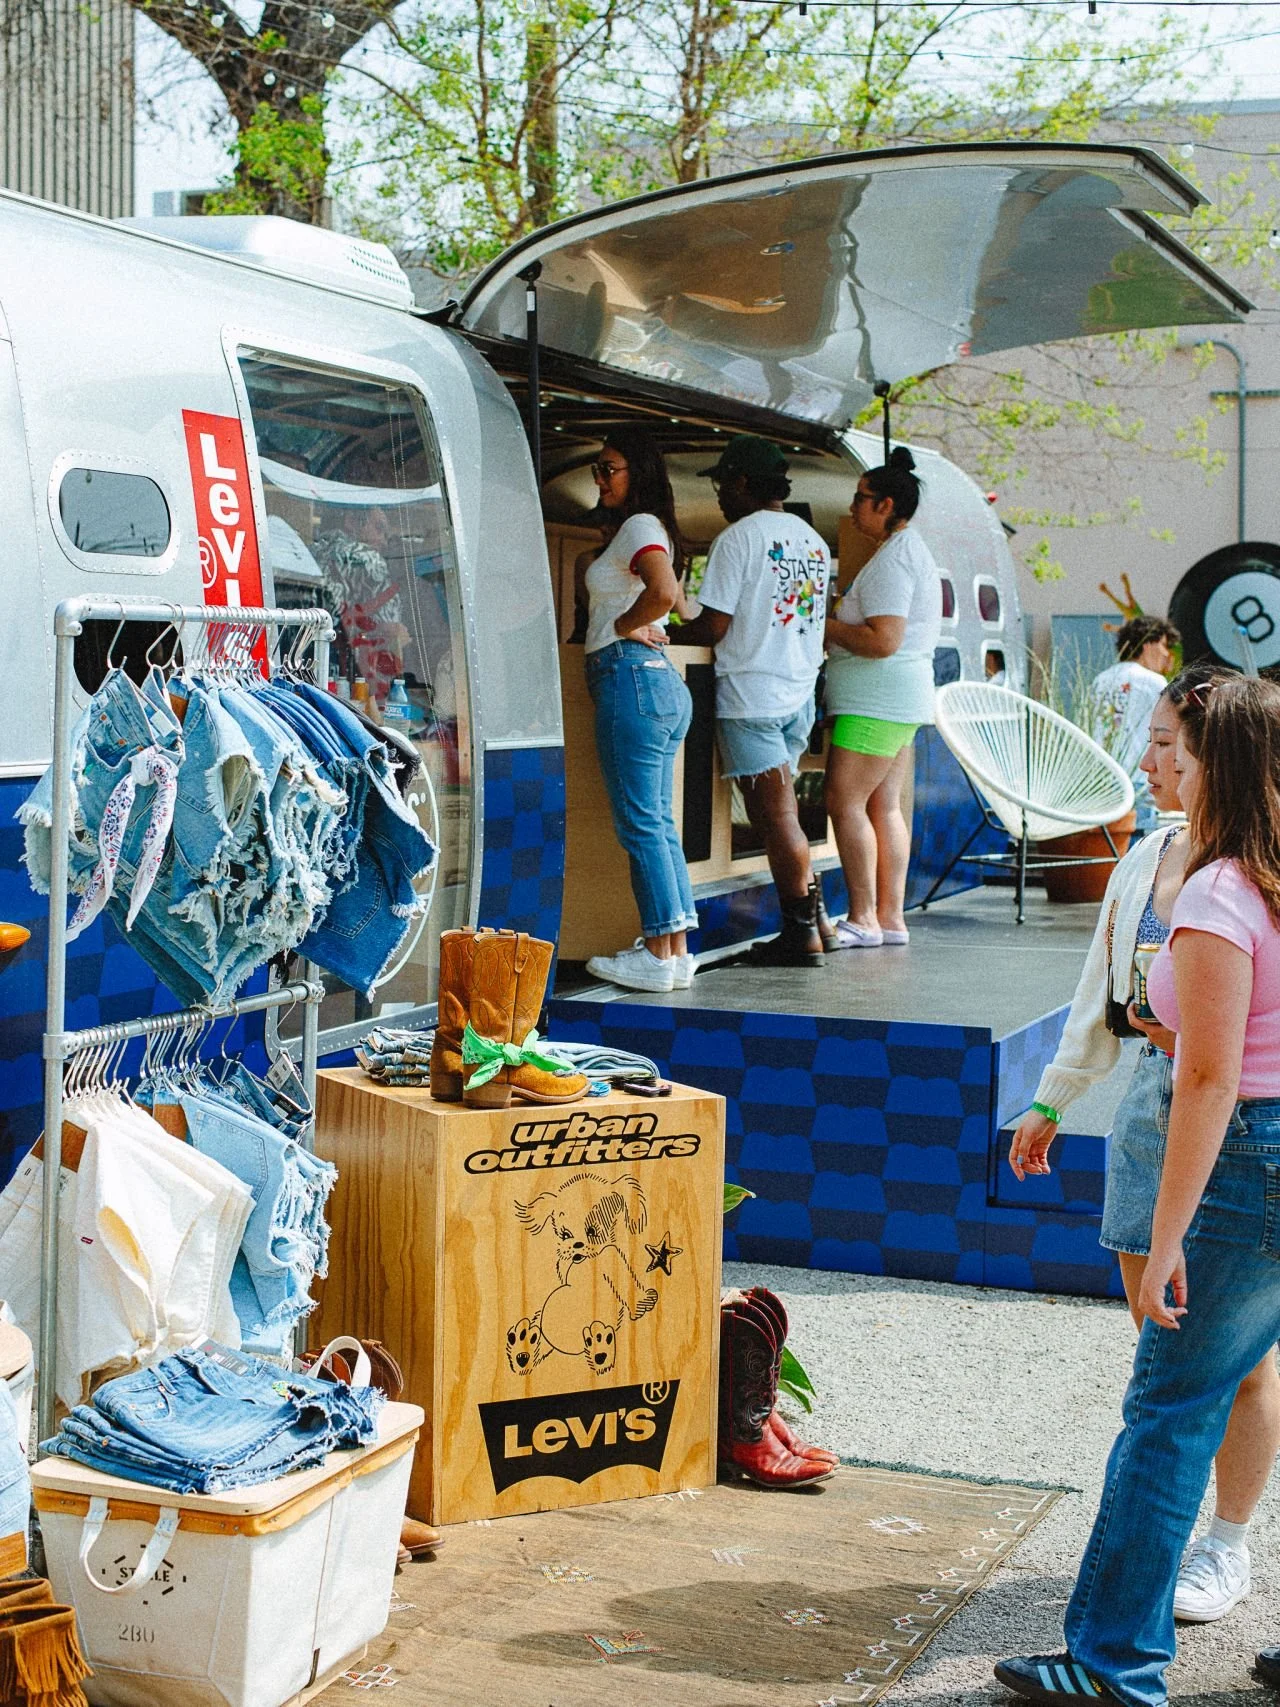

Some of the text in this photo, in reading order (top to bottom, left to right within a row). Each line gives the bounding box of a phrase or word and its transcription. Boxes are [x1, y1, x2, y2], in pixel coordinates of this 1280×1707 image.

[779, 558, 825, 580] STAFF
[1231, 595, 1275, 643] 8
[512, 1112, 657, 1145] urban
[465, 1134, 700, 1173] outfitters
[120, 1567, 170, 1582] STLE
